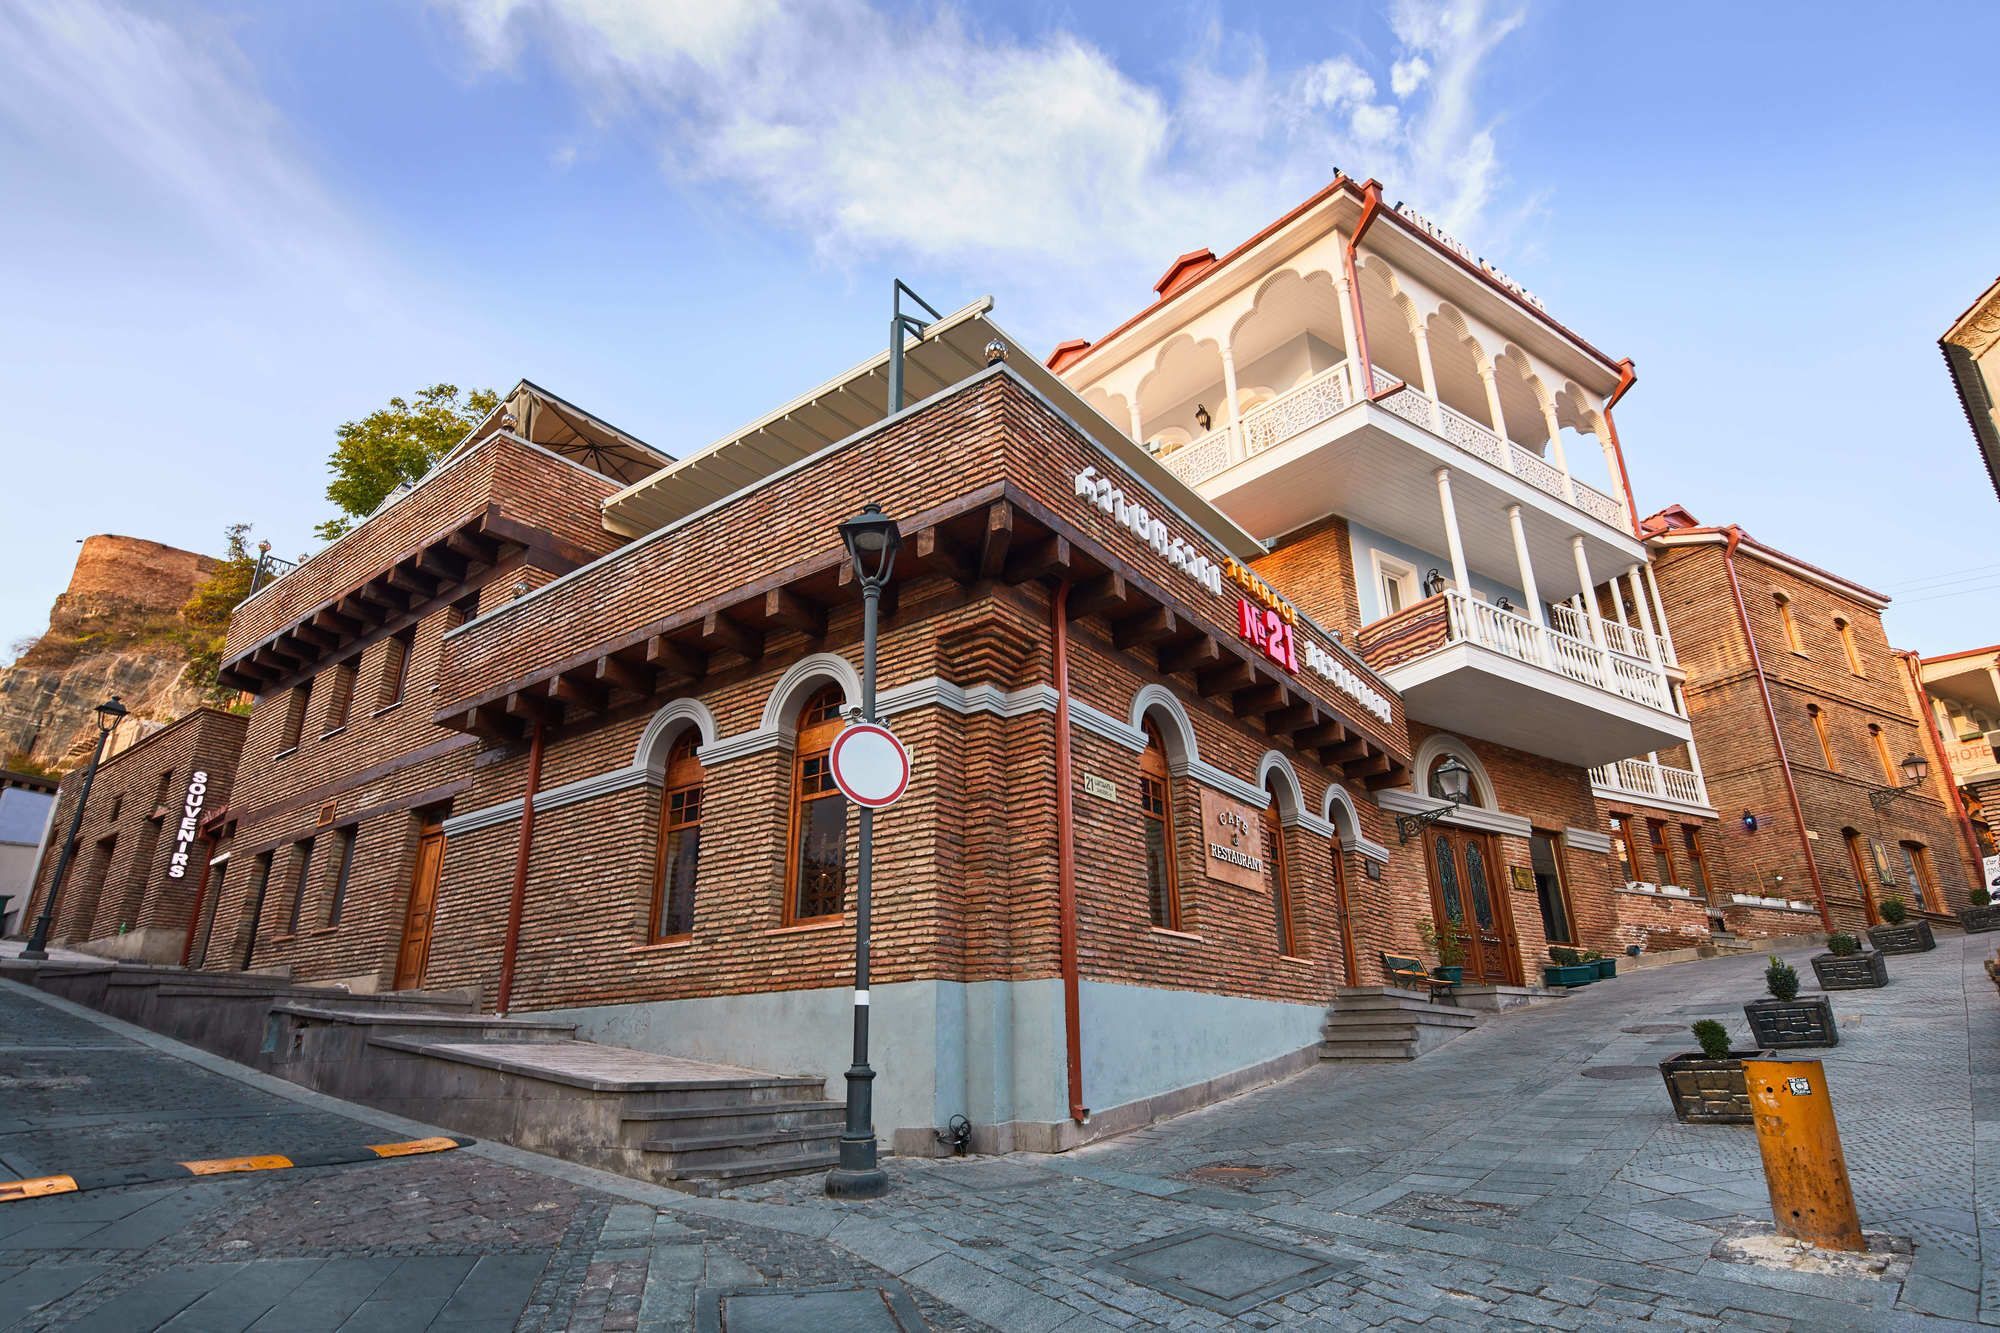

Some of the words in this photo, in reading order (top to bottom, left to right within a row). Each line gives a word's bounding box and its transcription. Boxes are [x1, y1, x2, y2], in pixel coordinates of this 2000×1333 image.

[1223, 556, 1299, 627] TERRACE
[1085, 776, 1094, 792] 21
[168, 771, 208, 878] SOUVENIRS
[1219, 811, 1249, 835] CAFE
[1232, 833, 1240, 846] &
[1210, 843, 1263, 873] RESTAURANT
